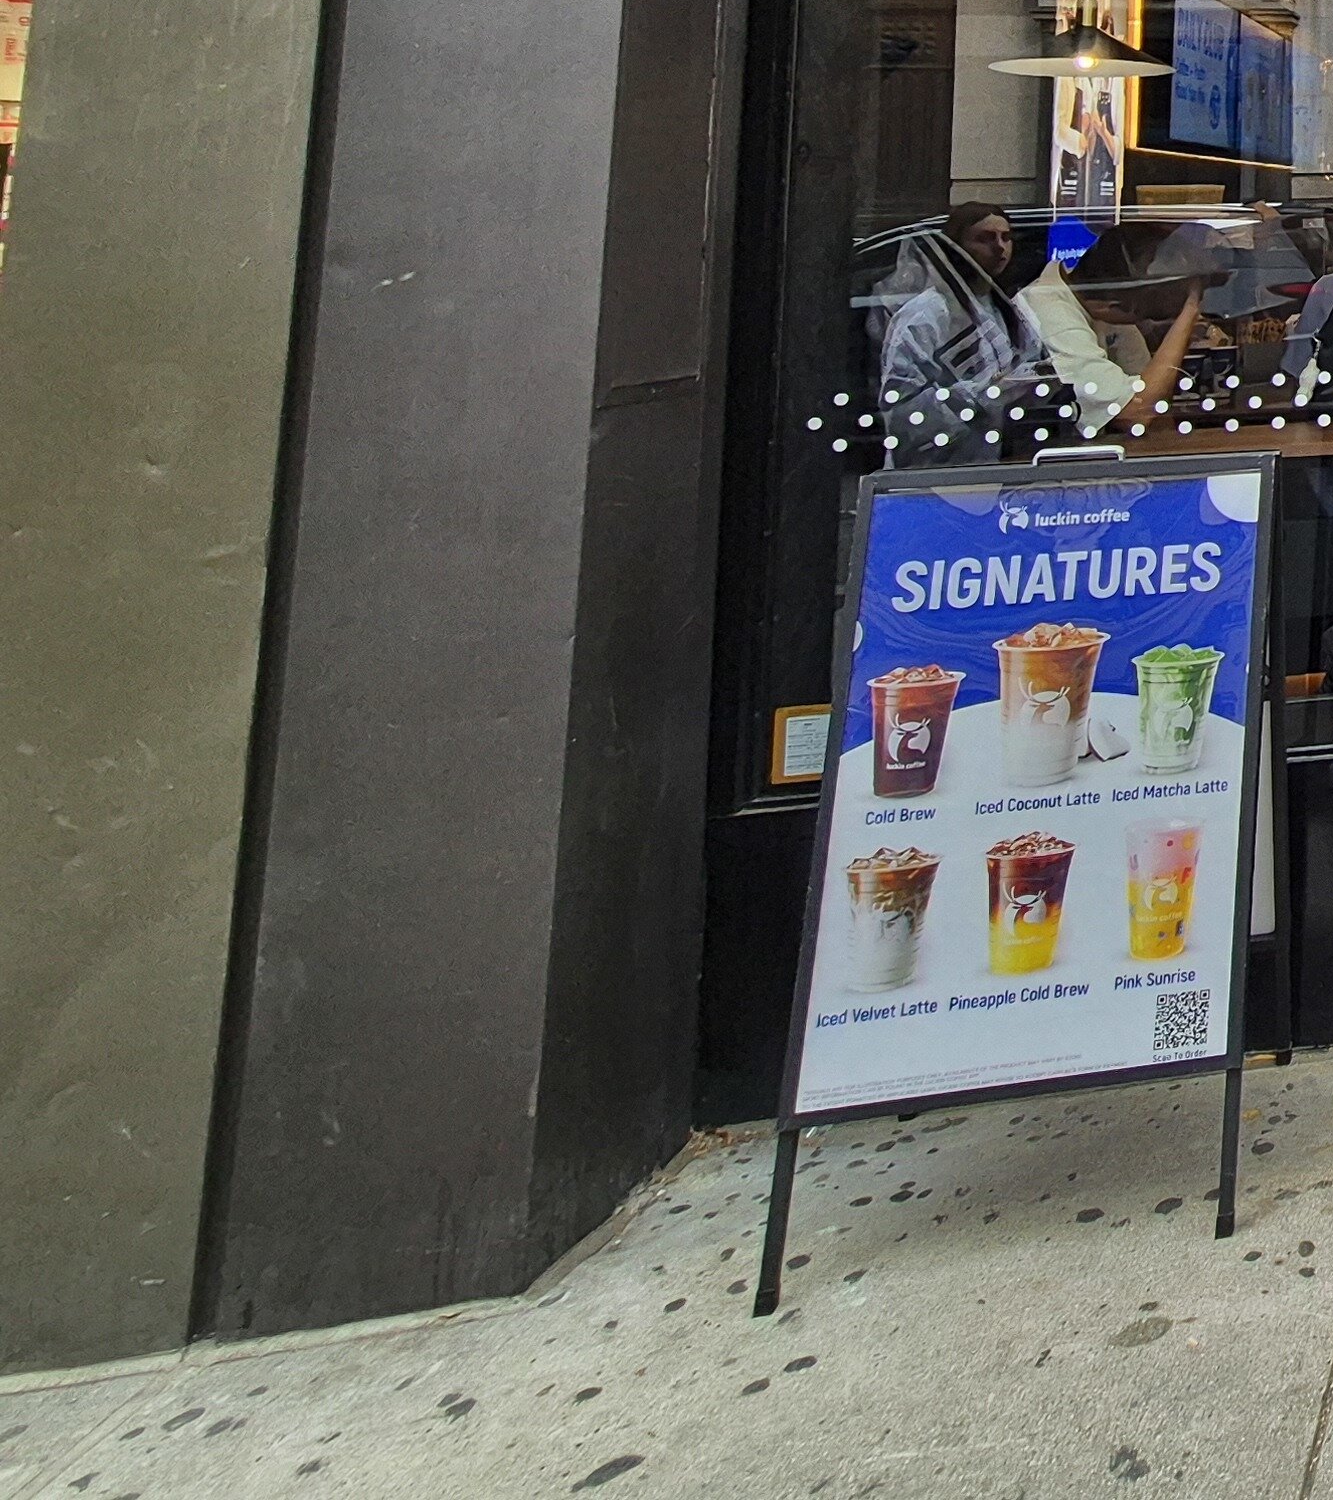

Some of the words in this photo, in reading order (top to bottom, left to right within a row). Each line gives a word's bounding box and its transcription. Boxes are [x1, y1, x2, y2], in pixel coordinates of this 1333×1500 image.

[1034, 510, 1081, 528] luckin
[1083, 507, 1131, 524] coffee
[891, 541, 1222, 614] SIGNATURES
[1111, 787, 1140, 803] Iced
[1142, 783, 1192, 800] Matcha
[1194, 779, 1229, 796] Latte
[865, 809, 896, 826] Cold
[900, 806, 936, 823] Brew
[975, 800, 1003, 816] Iced
[1007, 796, 1063, 814] Coconut
[1066, 792, 1101, 808] Latte
[1114, 974, 1143, 992] Pink
[1146, 968, 1196, 987] Sunrise
[948, 989, 1017, 1013] Pineapple
[1020, 985, 1050, 1003] Cold
[1053, 981, 1090, 999] Brew
[815, 1010, 848, 1029] Iced
[852, 1003, 897, 1025] Velvet
[900, 998, 938, 1019] Latte
[1184, 1049, 1207, 1059] Order
